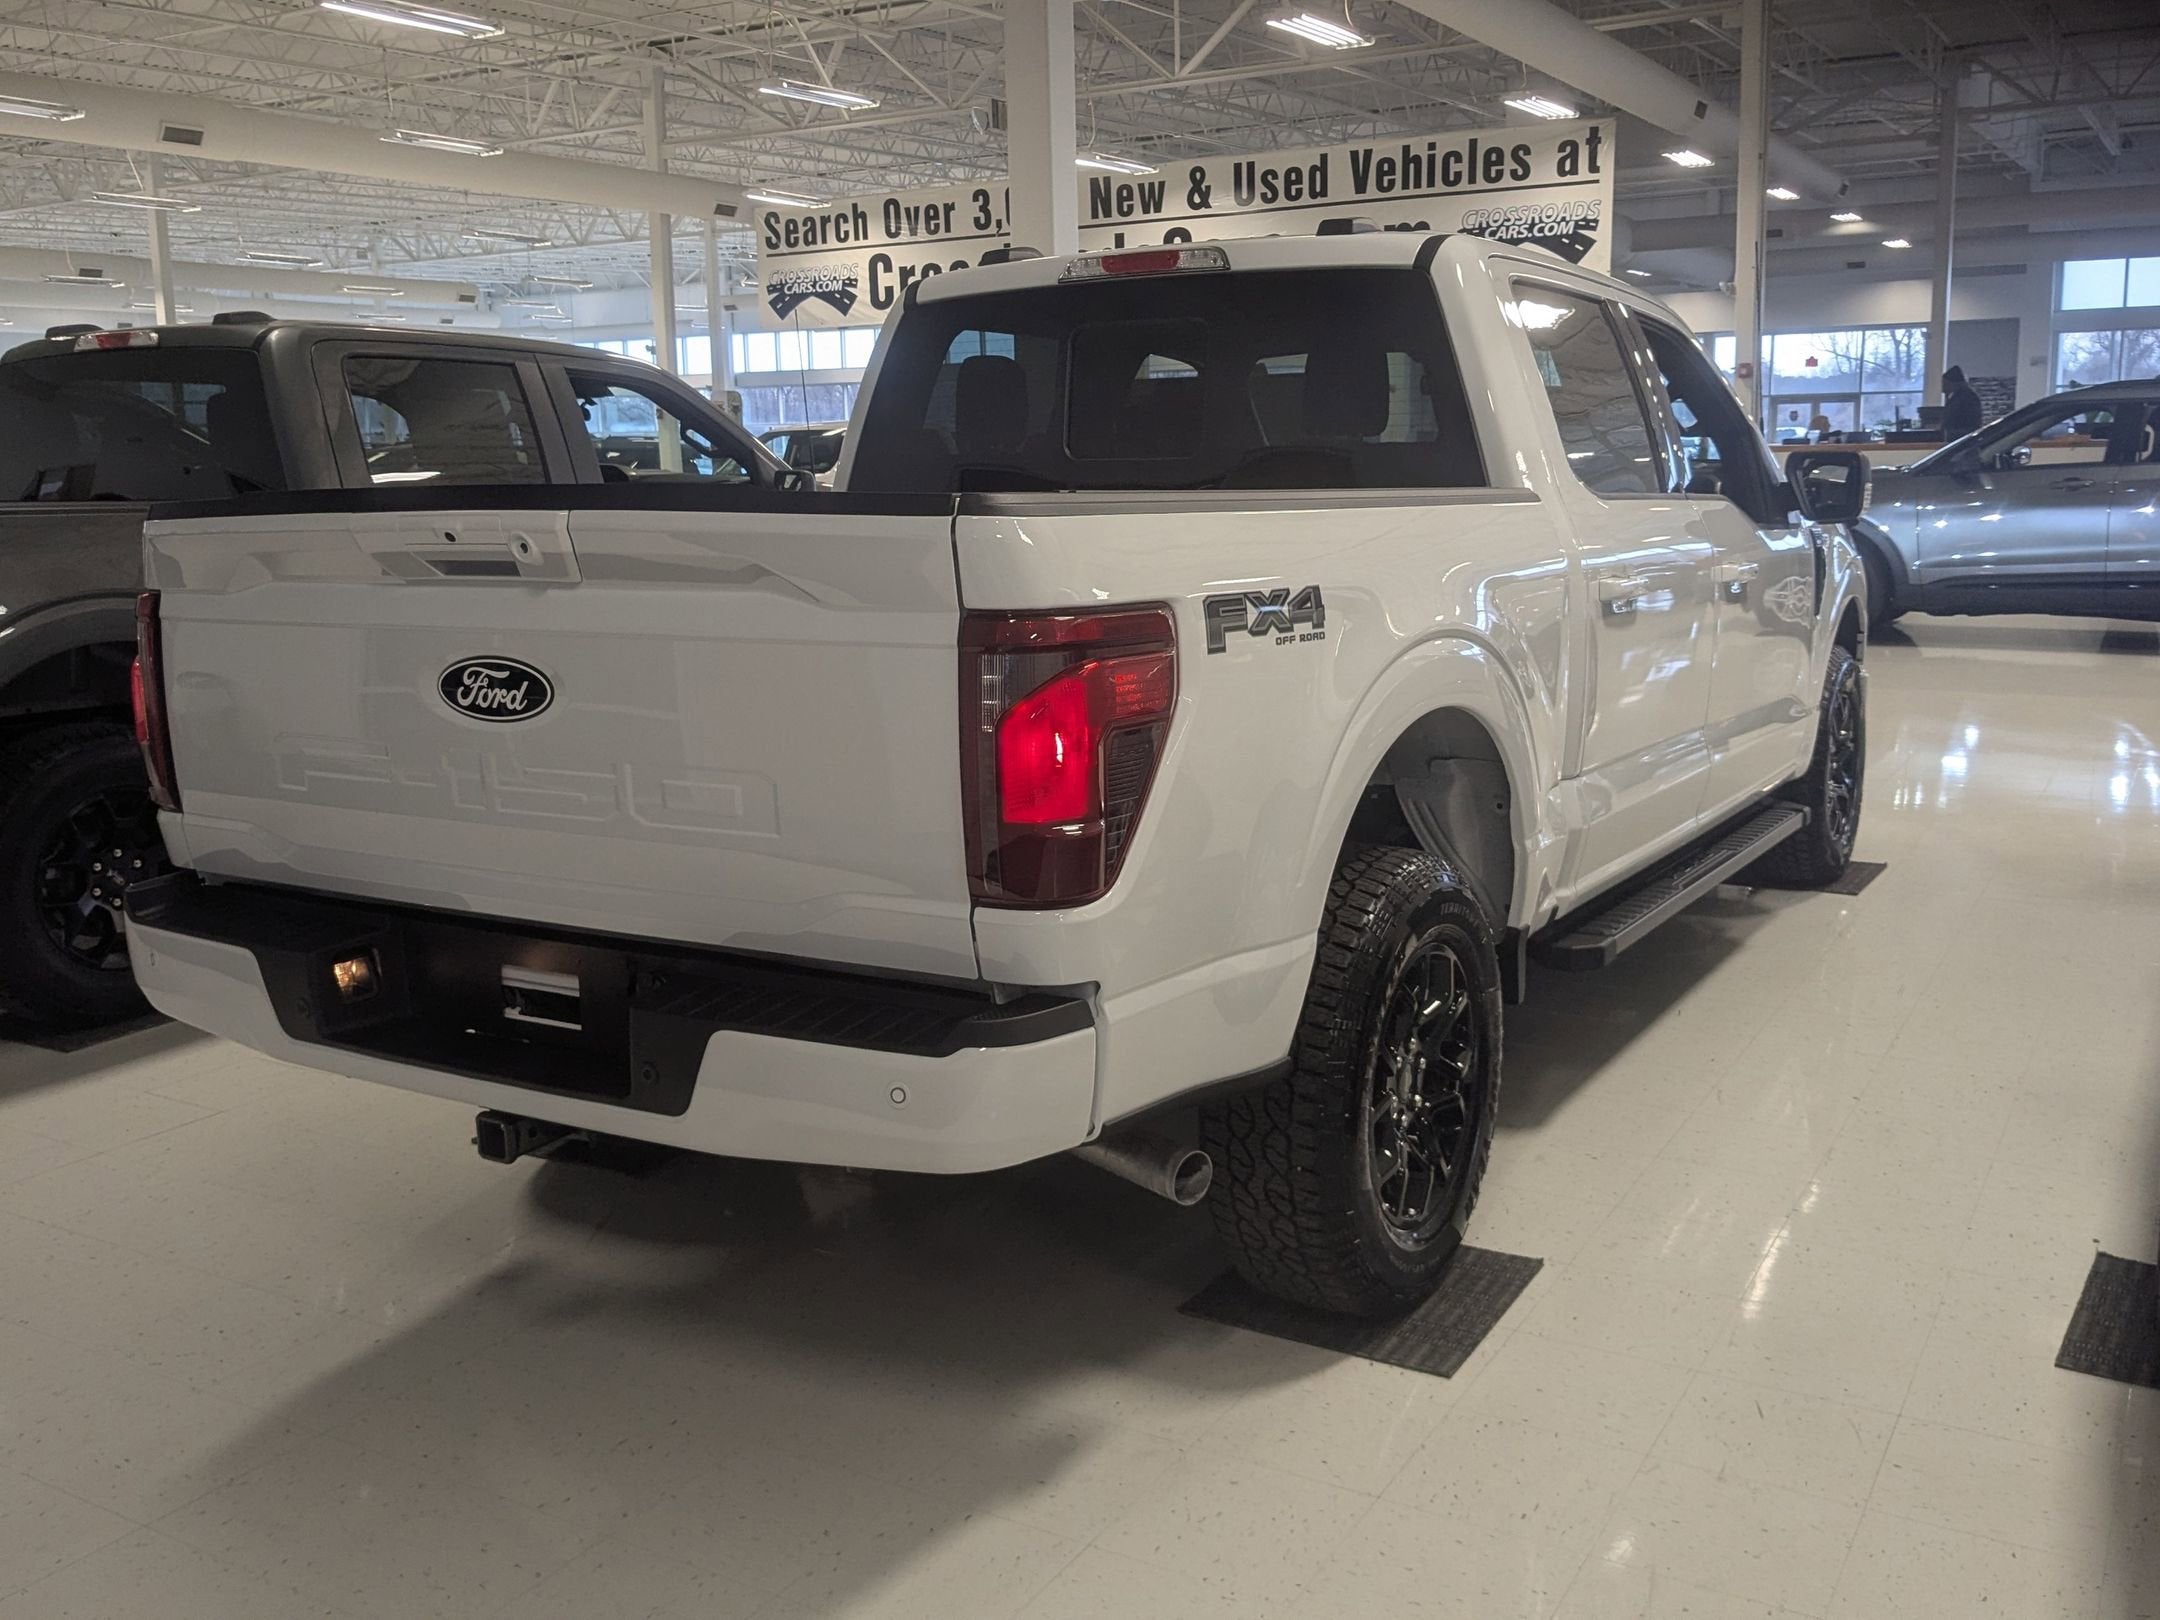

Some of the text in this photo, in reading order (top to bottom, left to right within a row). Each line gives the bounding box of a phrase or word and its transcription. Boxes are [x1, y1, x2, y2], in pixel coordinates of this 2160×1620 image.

[765, 202, 869, 250] Search
[883, 197, 956, 239] Over
[1090, 174, 1167, 220] New
[1187, 166, 1212, 210] &
[1233, 153, 1329, 206] Used
[1349, 138, 1532, 196] Vehicles
[1556, 127, 1601, 176] at
[1461, 200, 1601, 229] CROSSROADS
[1484, 220, 1574, 240] CARS.COM
[768, 262, 859, 285] CROSSROADS
[784, 280, 842, 295] CARS.COM
[1203, 584, 1325, 655] FX4
[1275, 631, 1325, 646] OFF ROAD
[457, 666, 529, 711] Ford
[274, 732, 782, 838] F-150
